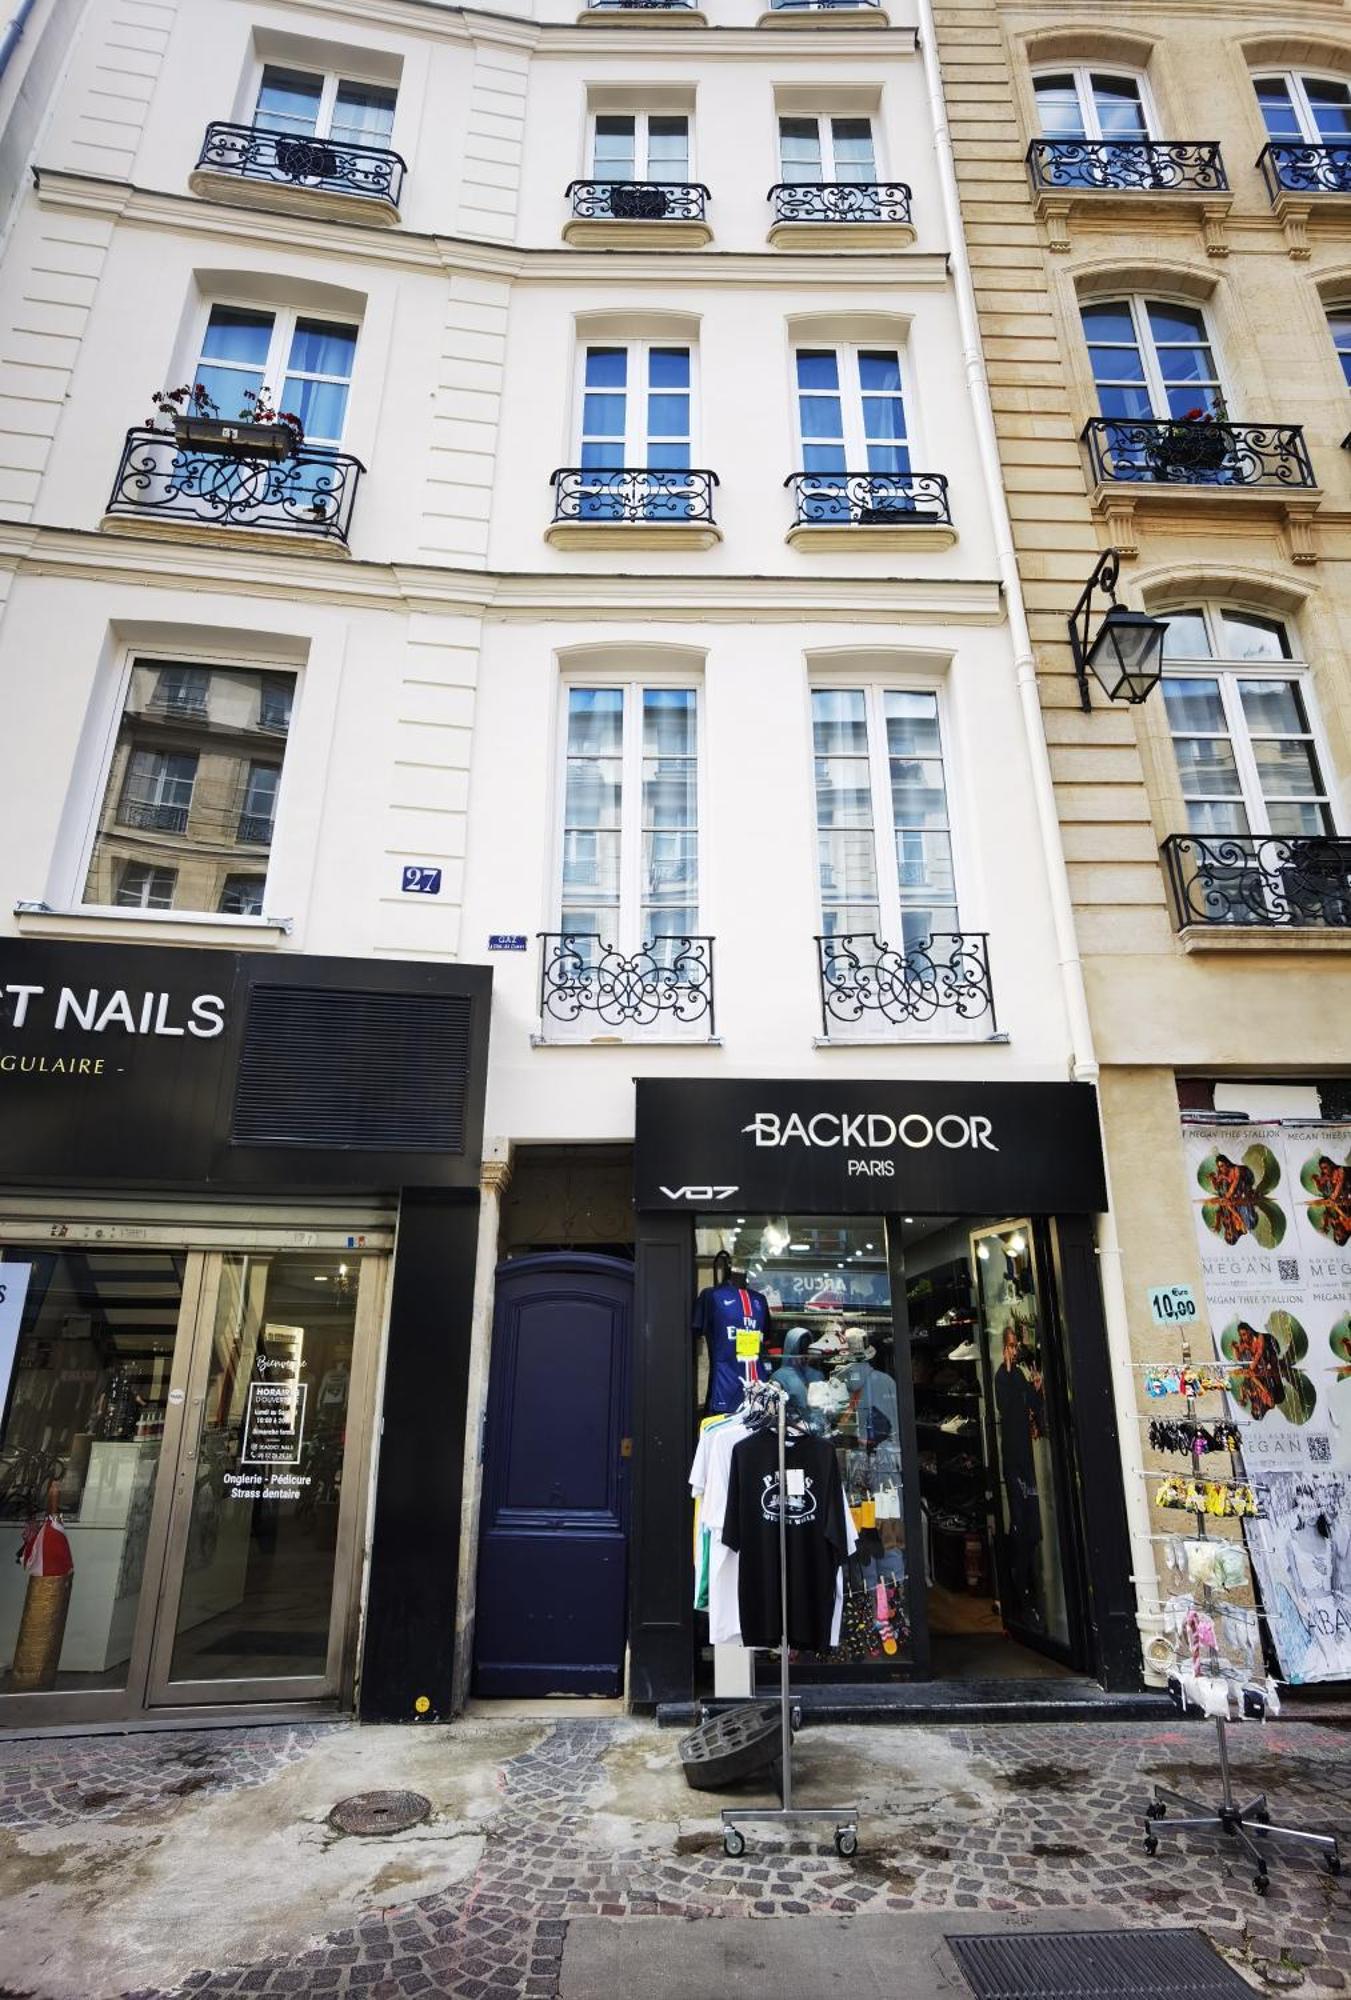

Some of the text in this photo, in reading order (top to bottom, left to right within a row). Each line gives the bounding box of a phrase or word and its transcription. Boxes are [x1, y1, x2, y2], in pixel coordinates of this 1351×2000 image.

[405, 867, 438, 892] 27
[0, 985, 225, 1038] T NAILS
[0, 1055, 105, 1074] GULAIRE
[741, 1113, 999, 1151] BACKDOOR
[848, 1160, 895, 1177] PARIS
[1203, 1262, 1272, 1275] MEGAN
[1152, 1293, 1196, 1320] 10,00
[1248, 1440, 1302, 1453] EGAN
[223, 1473, 262, 1486] Onglerie
[270, 1473, 312, 1486] Pédicure
[230, 1487, 300, 1500] Strass dentaire
